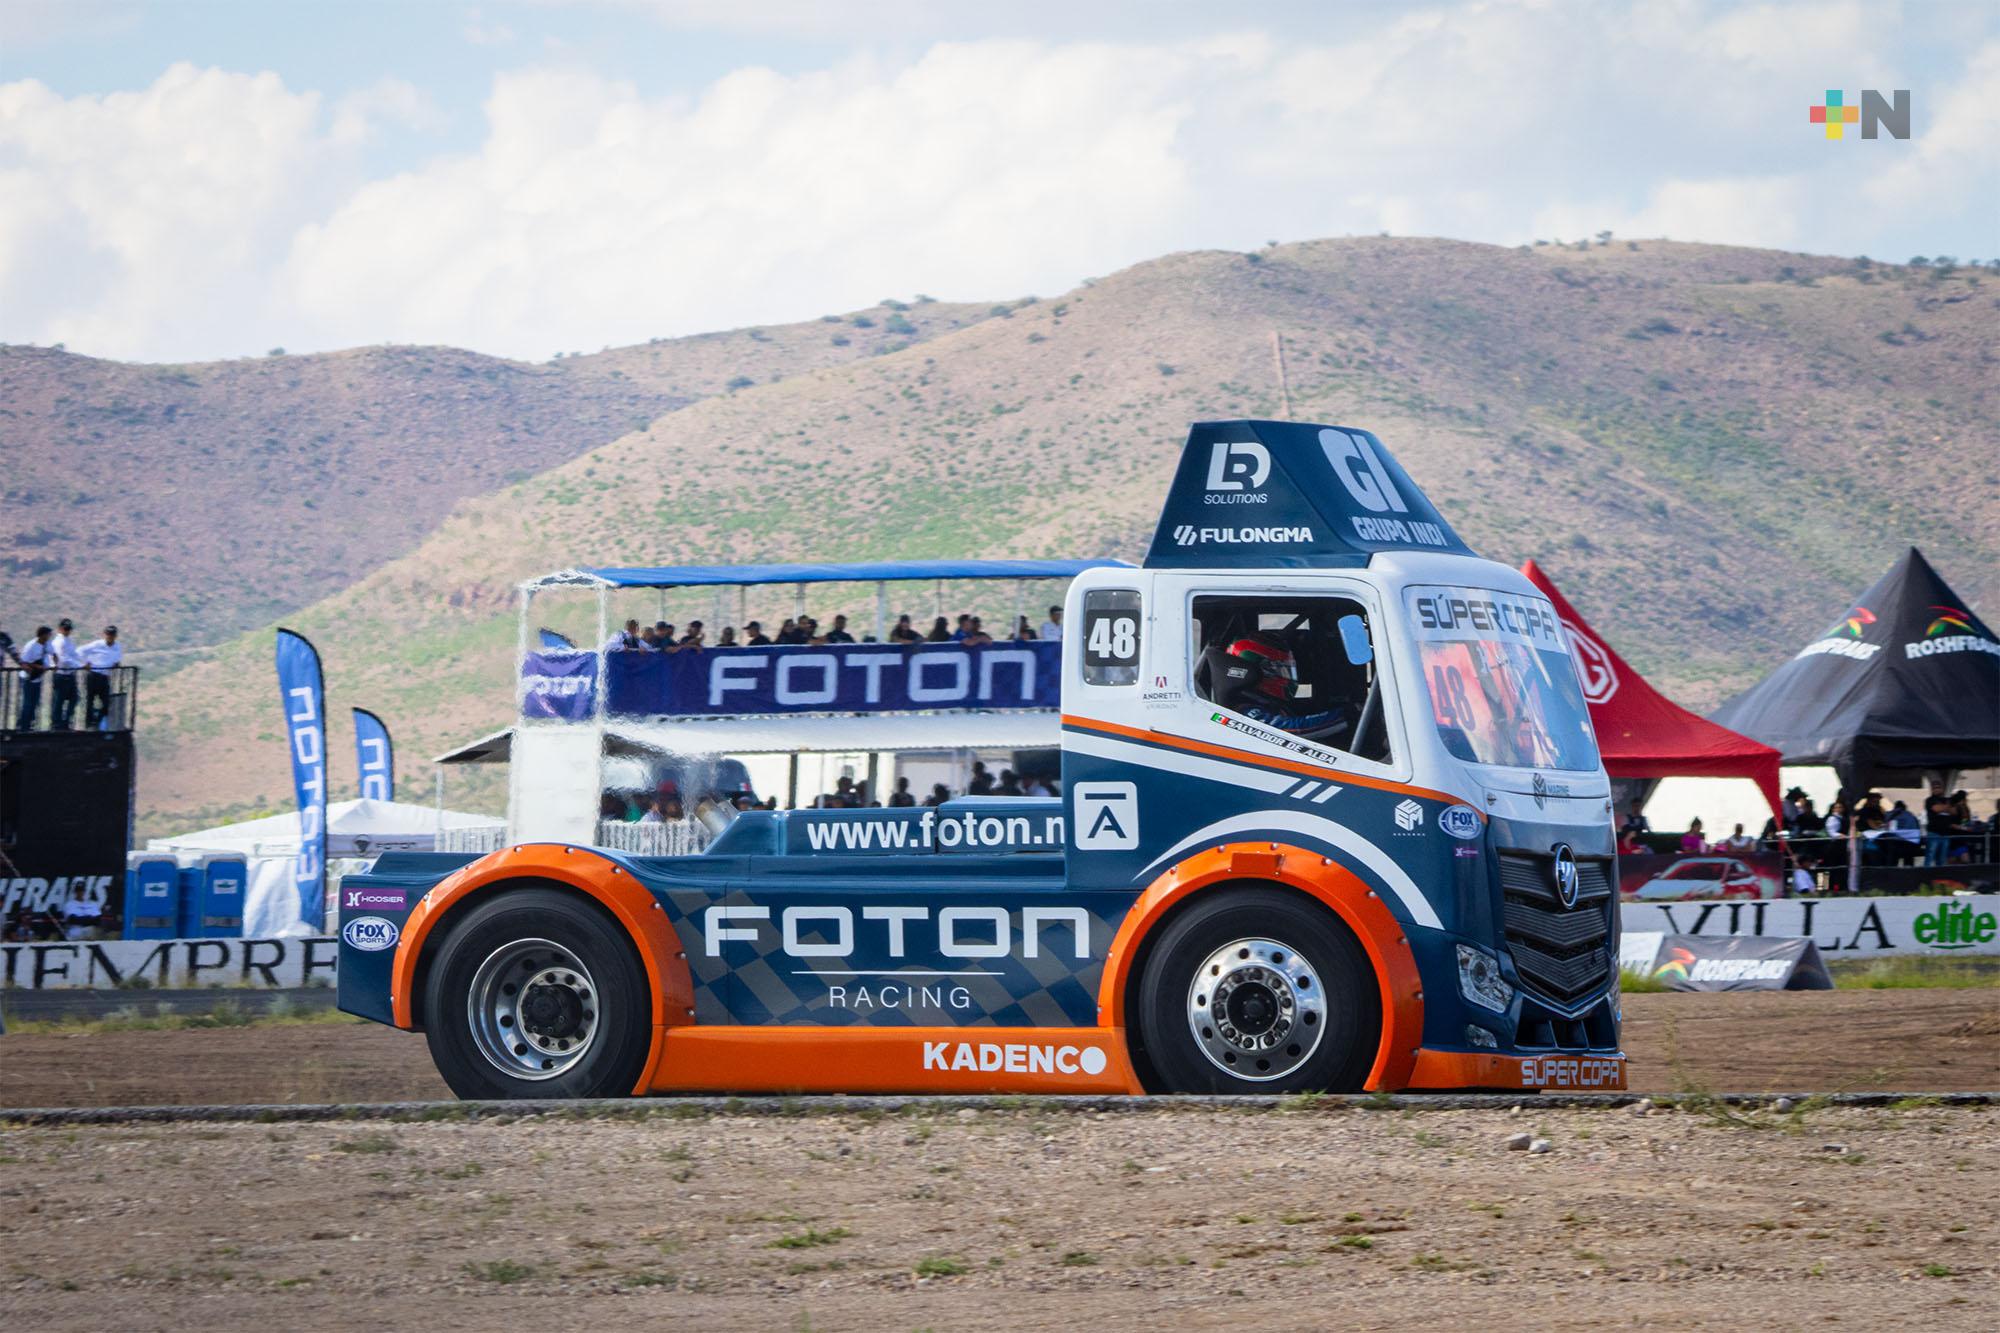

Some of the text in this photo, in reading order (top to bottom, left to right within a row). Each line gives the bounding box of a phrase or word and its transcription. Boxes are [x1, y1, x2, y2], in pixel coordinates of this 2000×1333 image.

[1203, 493, 1268, 505] SOLUTIONS
[1200, 527, 1314, 543] FULONGMA
[1352, 515, 1448, 547] GRUPO INDI
[1416, 593, 1559, 642] SÚPER COPA
[1088, 617, 1136, 659] 48
[708, 650, 1037, 706] FOTON
[1142, 692, 1181, 701] ANDRETTI
[1432, 664, 1477, 732] 48
[1227, 718, 1336, 765] SALVADOR DE ALBA
[1451, 811, 1474, 826] FOX
[361, 895, 405, 904] HOOSIER
[356, 924, 386, 938] FOX
[704, 906, 1090, 959] FOTON
[829, 986, 971, 1009] RACING
[923, 1042, 1107, 1075] KADENCO
[1521, 1060, 1620, 1086] SUPER COPA
